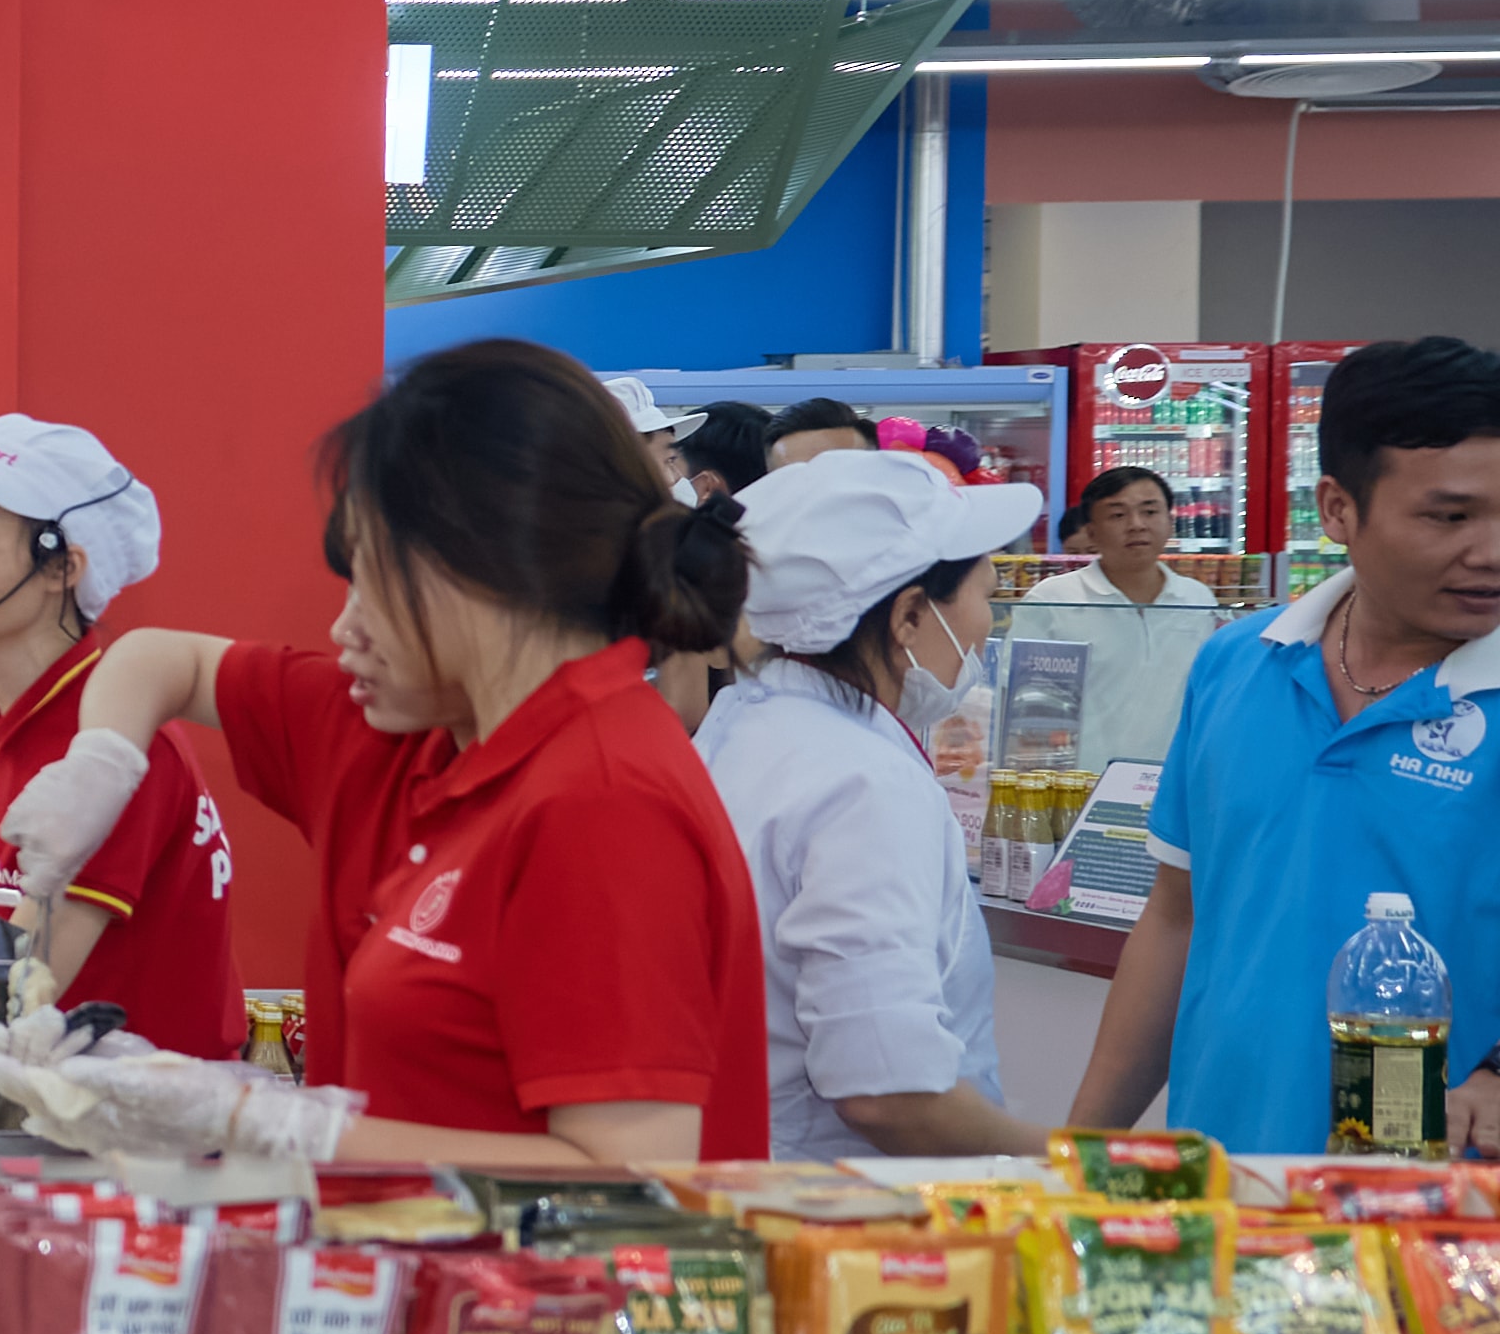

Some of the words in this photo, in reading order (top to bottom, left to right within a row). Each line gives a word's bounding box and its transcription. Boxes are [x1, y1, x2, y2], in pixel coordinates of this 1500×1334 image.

[1183, 368, 1203, 378] ICE
[1211, 368, 1245, 378] COLD
[1425, 763, 1474, 785] NHU
